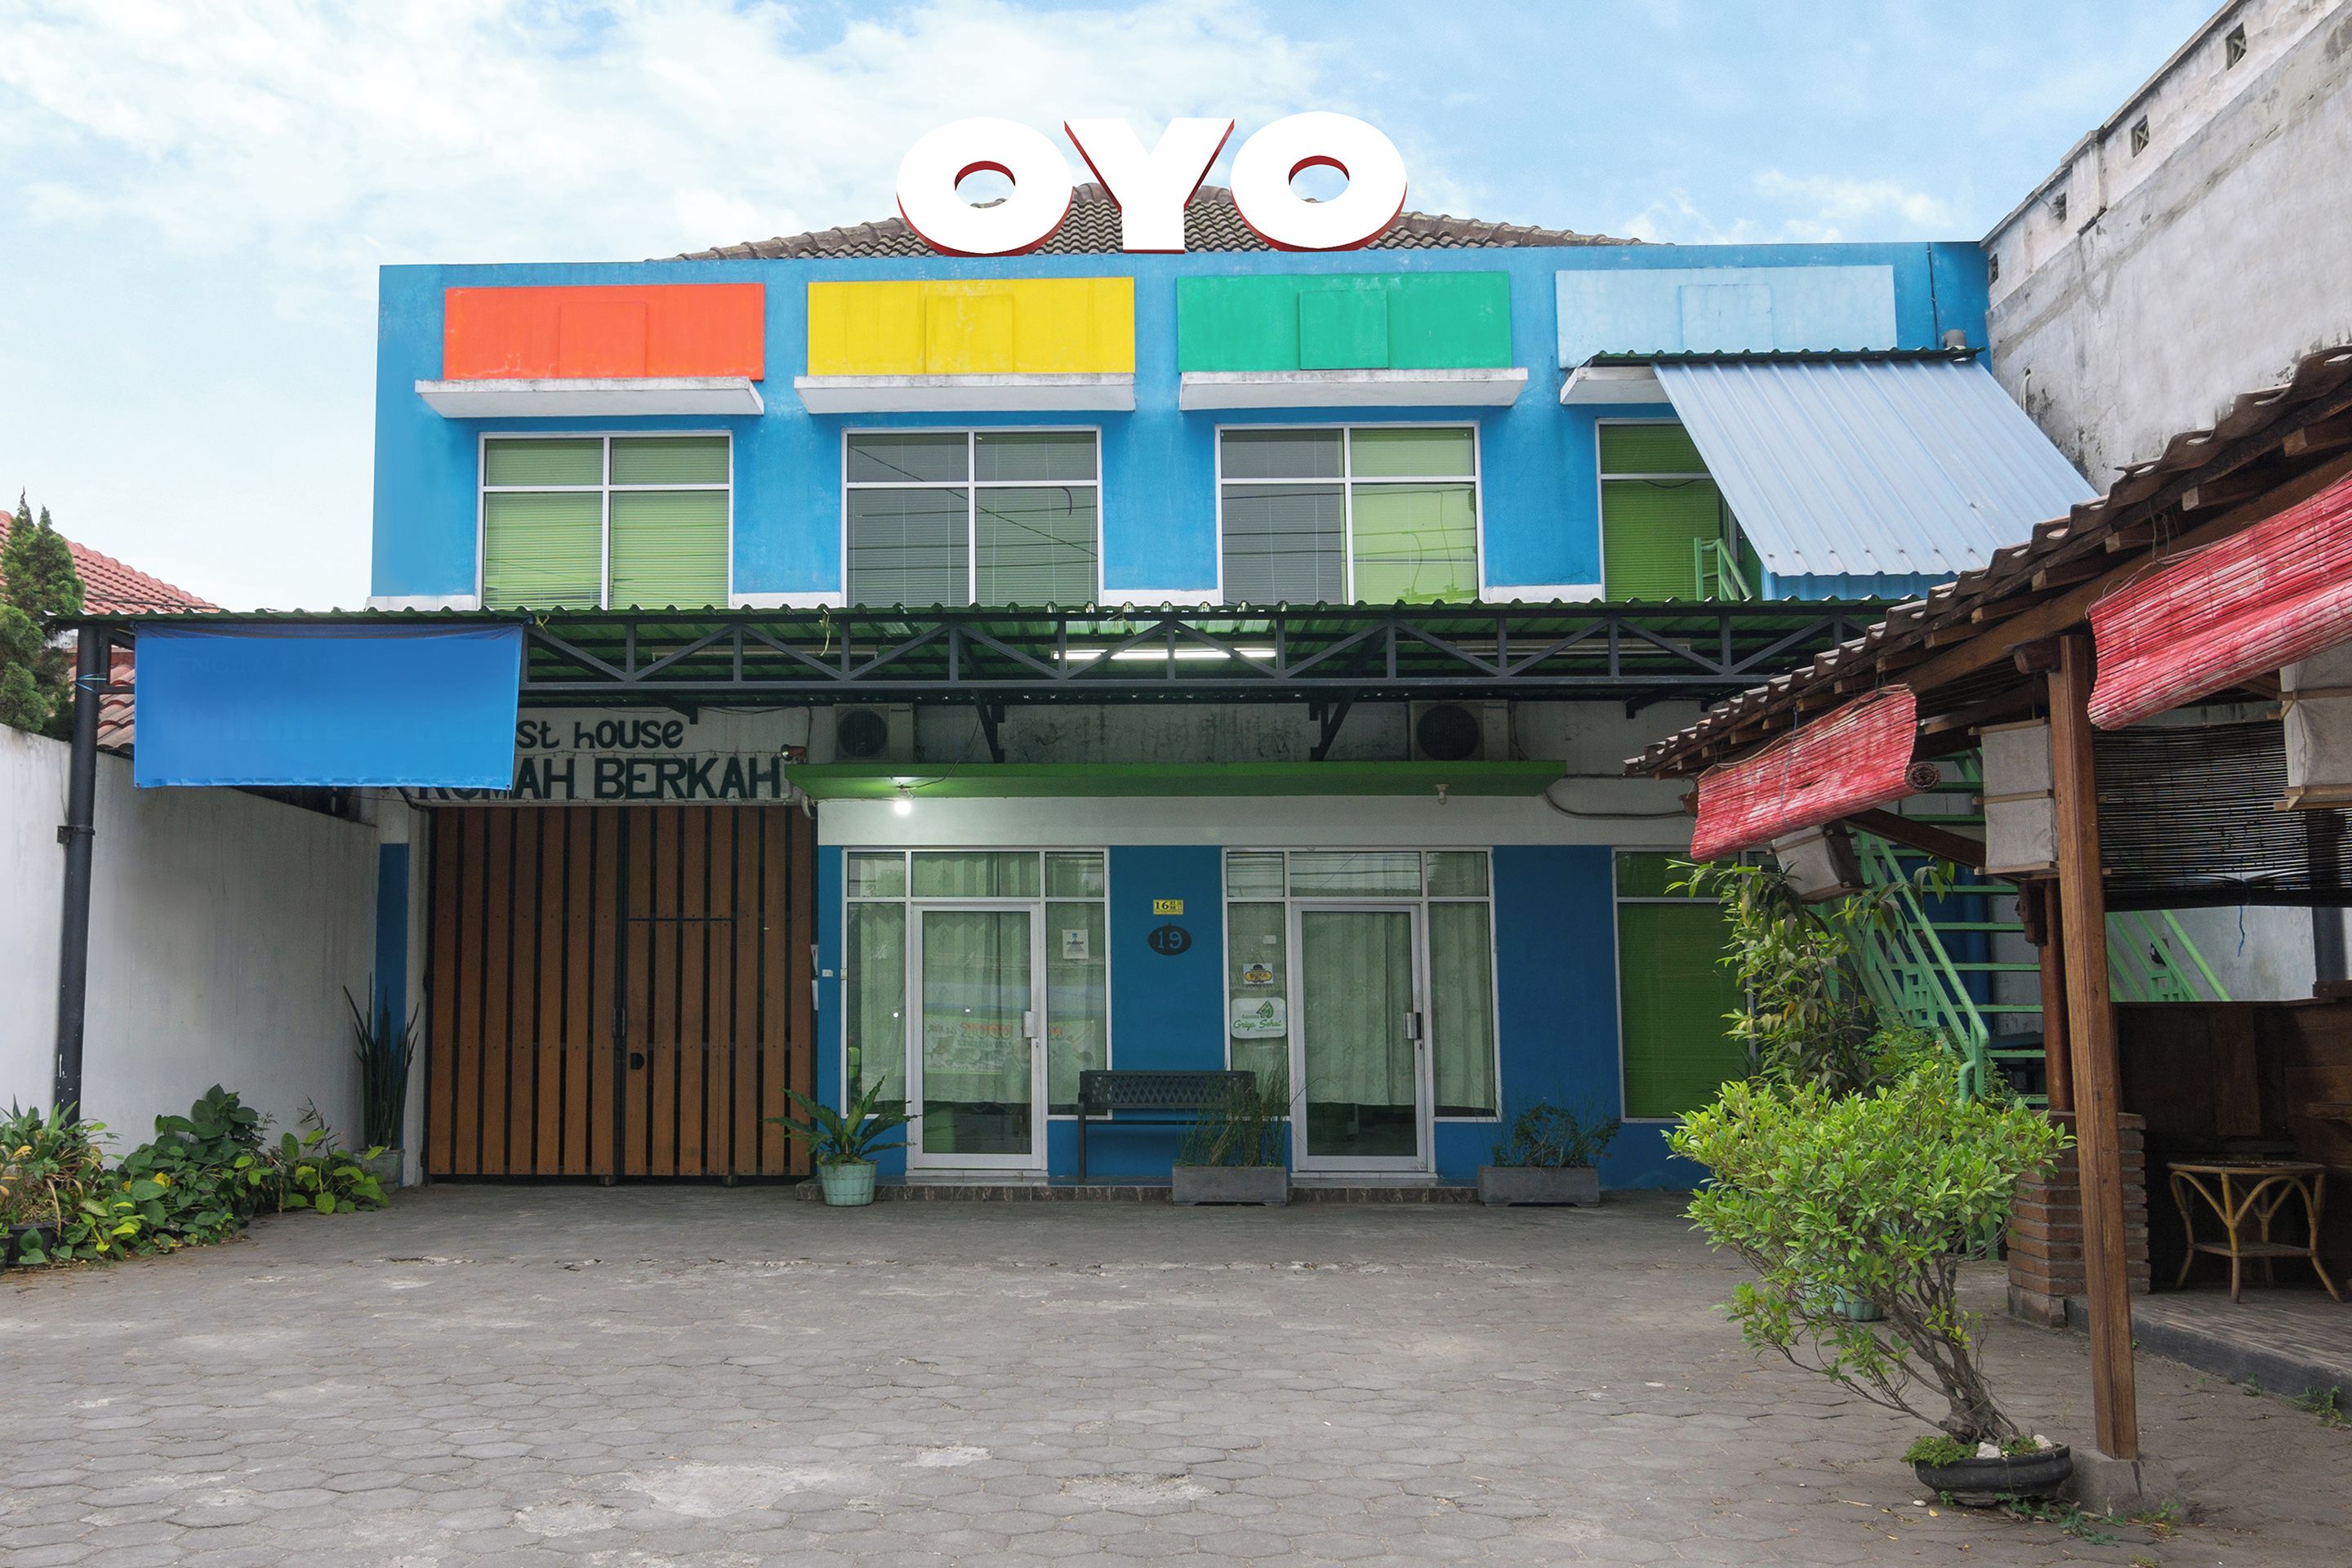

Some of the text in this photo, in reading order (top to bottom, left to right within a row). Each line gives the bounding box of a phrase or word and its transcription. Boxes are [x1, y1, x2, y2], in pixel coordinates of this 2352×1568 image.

[896, 111, 1407, 256] OYO
[573, 719, 684, 749] house
[595, 757, 781, 799] BERKAH
[1157, 932, 1183, 949] 19
